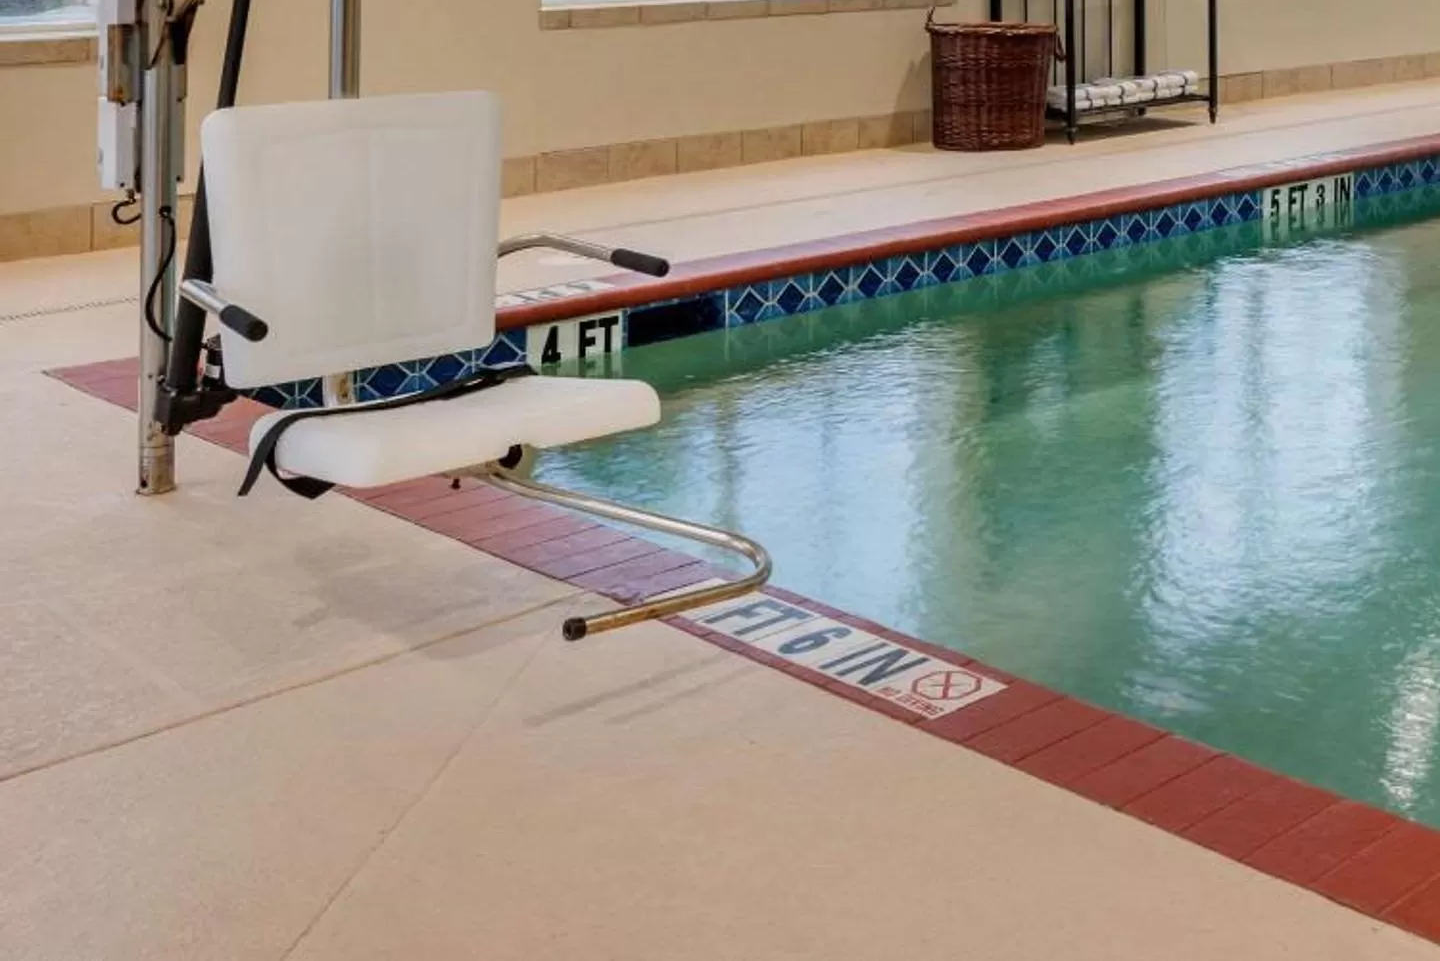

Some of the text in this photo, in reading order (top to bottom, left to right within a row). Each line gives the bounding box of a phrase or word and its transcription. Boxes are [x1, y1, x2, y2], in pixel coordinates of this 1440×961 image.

[1270, 176, 1351, 216] 5 FT 3 IN
[541, 315, 620, 364] 4 FT
[703, 599, 931, 687] FT 6 IN
